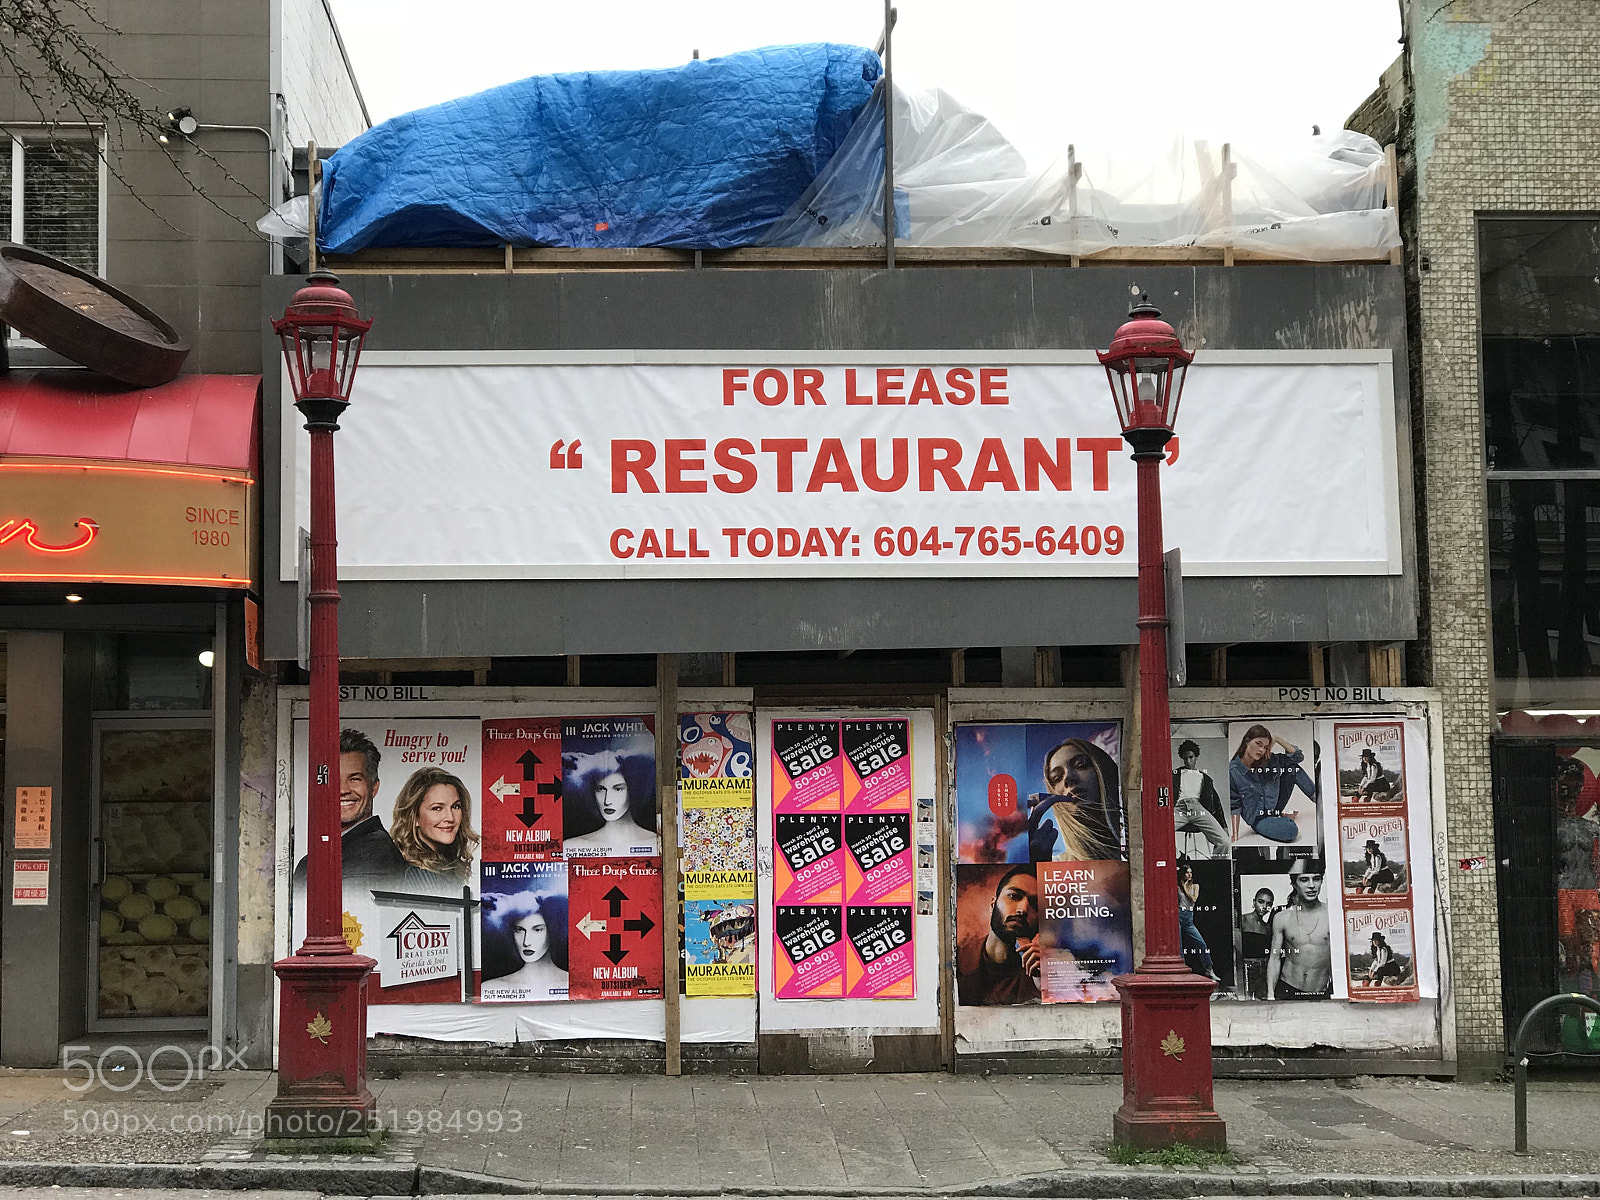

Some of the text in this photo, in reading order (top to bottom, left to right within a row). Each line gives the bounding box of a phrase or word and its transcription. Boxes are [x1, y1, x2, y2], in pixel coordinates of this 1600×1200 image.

[722, 368, 1009, 406] FOR LEASE
[610, 437, 1123, 494] RESTAURANT
[185, 506, 239, 525] SINCE
[191, 529, 230, 547] 1980
[610, 525, 1125, 559] CALL TODAY: 604-765-6409
[339, 686, 428, 700] ST NO BILL
[1278, 688, 1385, 701] POST NO BILL
[581, 722, 610, 733] JACK
[613, 722, 645, 732] WHIT
[384, 729, 449, 750] Hungry to
[782, 735, 828, 762] warehouse
[852, 735, 897, 761] warehouse
[401, 745, 468, 766] serve you!
[789, 744, 834, 776] sale
[858, 743, 903, 775] sale
[318, 764, 328, 774] 12
[316, 774, 328, 785] 51
[684, 778, 751, 790] MURAKAMI
[1159, 787, 1169, 797] 10
[1158, 798, 1169, 807] 51
[506, 830, 551, 842] NEW ALBUM
[785, 827, 830, 854] warehouse
[854, 827, 899, 854] warehouse
[514, 843, 545, 852] OUTSIDER
[791, 836, 836, 868] sale
[860, 836, 905, 868] sale
[15, 863, 32, 871] 50%
[500, 862, 530, 873] JACK
[686, 872, 754, 884] MURAKAMI
[1044, 870, 1095, 882] LEARN
[1044, 882, 1088, 894] MORE
[1045, 894, 1100, 906] TO GET
[1045, 906, 1114, 919] ROLLING.
[785, 920, 830, 946] warehouse
[855, 920, 900, 946] warehouse
[403, 931, 450, 950] COBY
[791, 928, 836, 960] sale
[862, 928, 906, 960] sale
[400, 964, 447, 978] HAMMOND
[593, 966, 638, 980] NEW ALBUM
[688, 965, 754, 976] MURAKAMI
[601, 980, 632, 990] OUTSIDER
